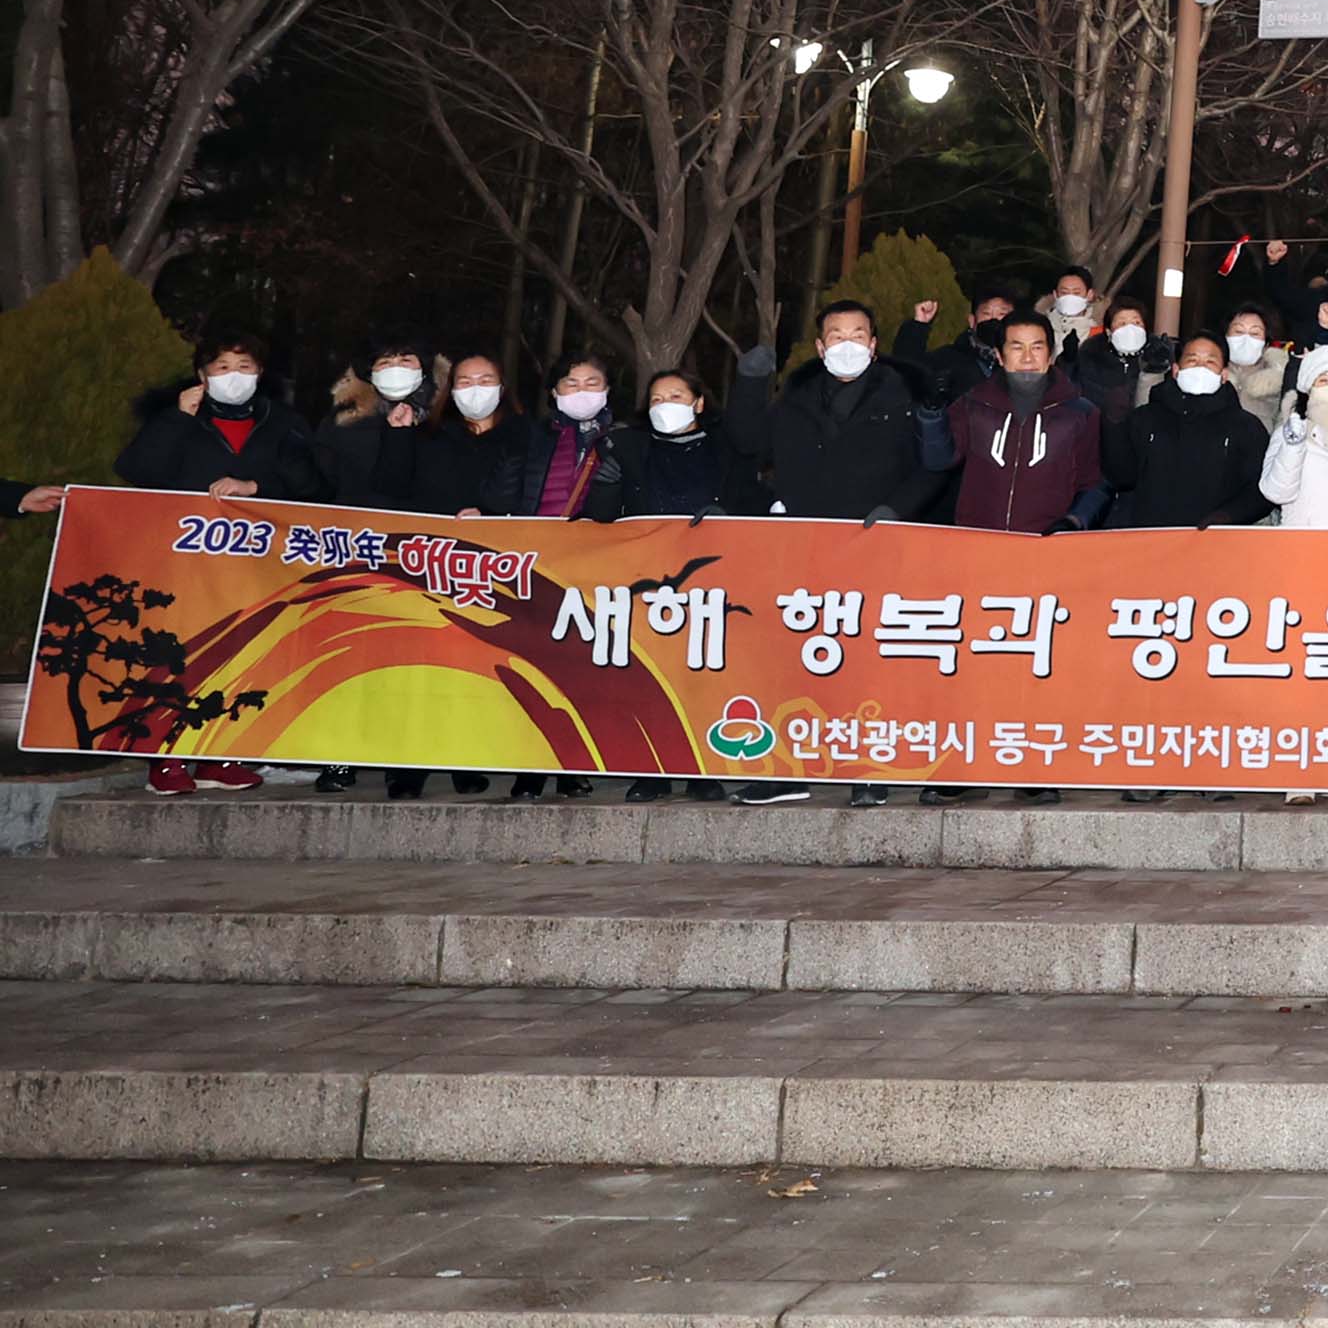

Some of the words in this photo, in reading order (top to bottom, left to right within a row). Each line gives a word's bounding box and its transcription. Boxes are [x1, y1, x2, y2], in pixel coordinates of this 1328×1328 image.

[172, 515, 273, 557] 2023
[281, 525, 388, 568] 癸卯年
[397, 535, 538, 608] 해맞이
[551, 584, 728, 672] 새해
[776, 588, 1069, 678] 행복과
[787, 717, 974, 764] 인천광역시
[988, 722, 1068, 766] 동구
